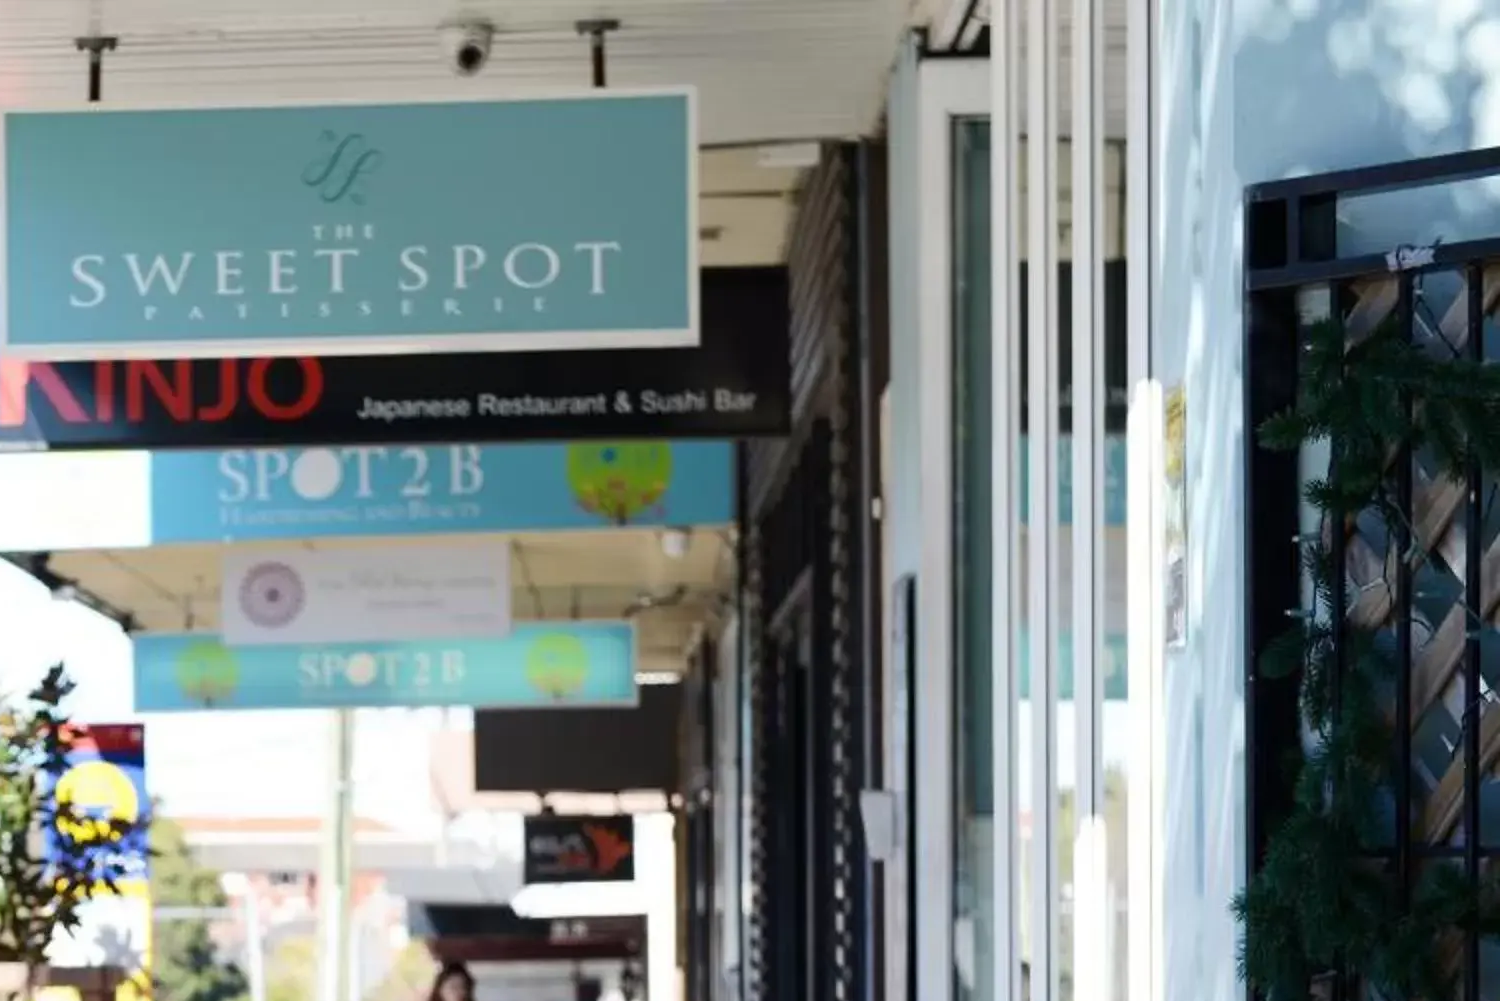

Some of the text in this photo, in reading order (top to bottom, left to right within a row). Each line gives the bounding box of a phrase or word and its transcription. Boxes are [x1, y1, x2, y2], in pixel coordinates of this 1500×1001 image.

[313, 224, 375, 240] THE
[69, 241, 622, 308] SWEET SPOT
[144, 296, 549, 321] PATISSERIE
[357, 388, 758, 423] Japanese Restaurant & Sushi Bar
[218, 445, 484, 502] SPOT 2 B
[298, 651, 406, 687] SPOT
[413, 651, 431, 686] 2
